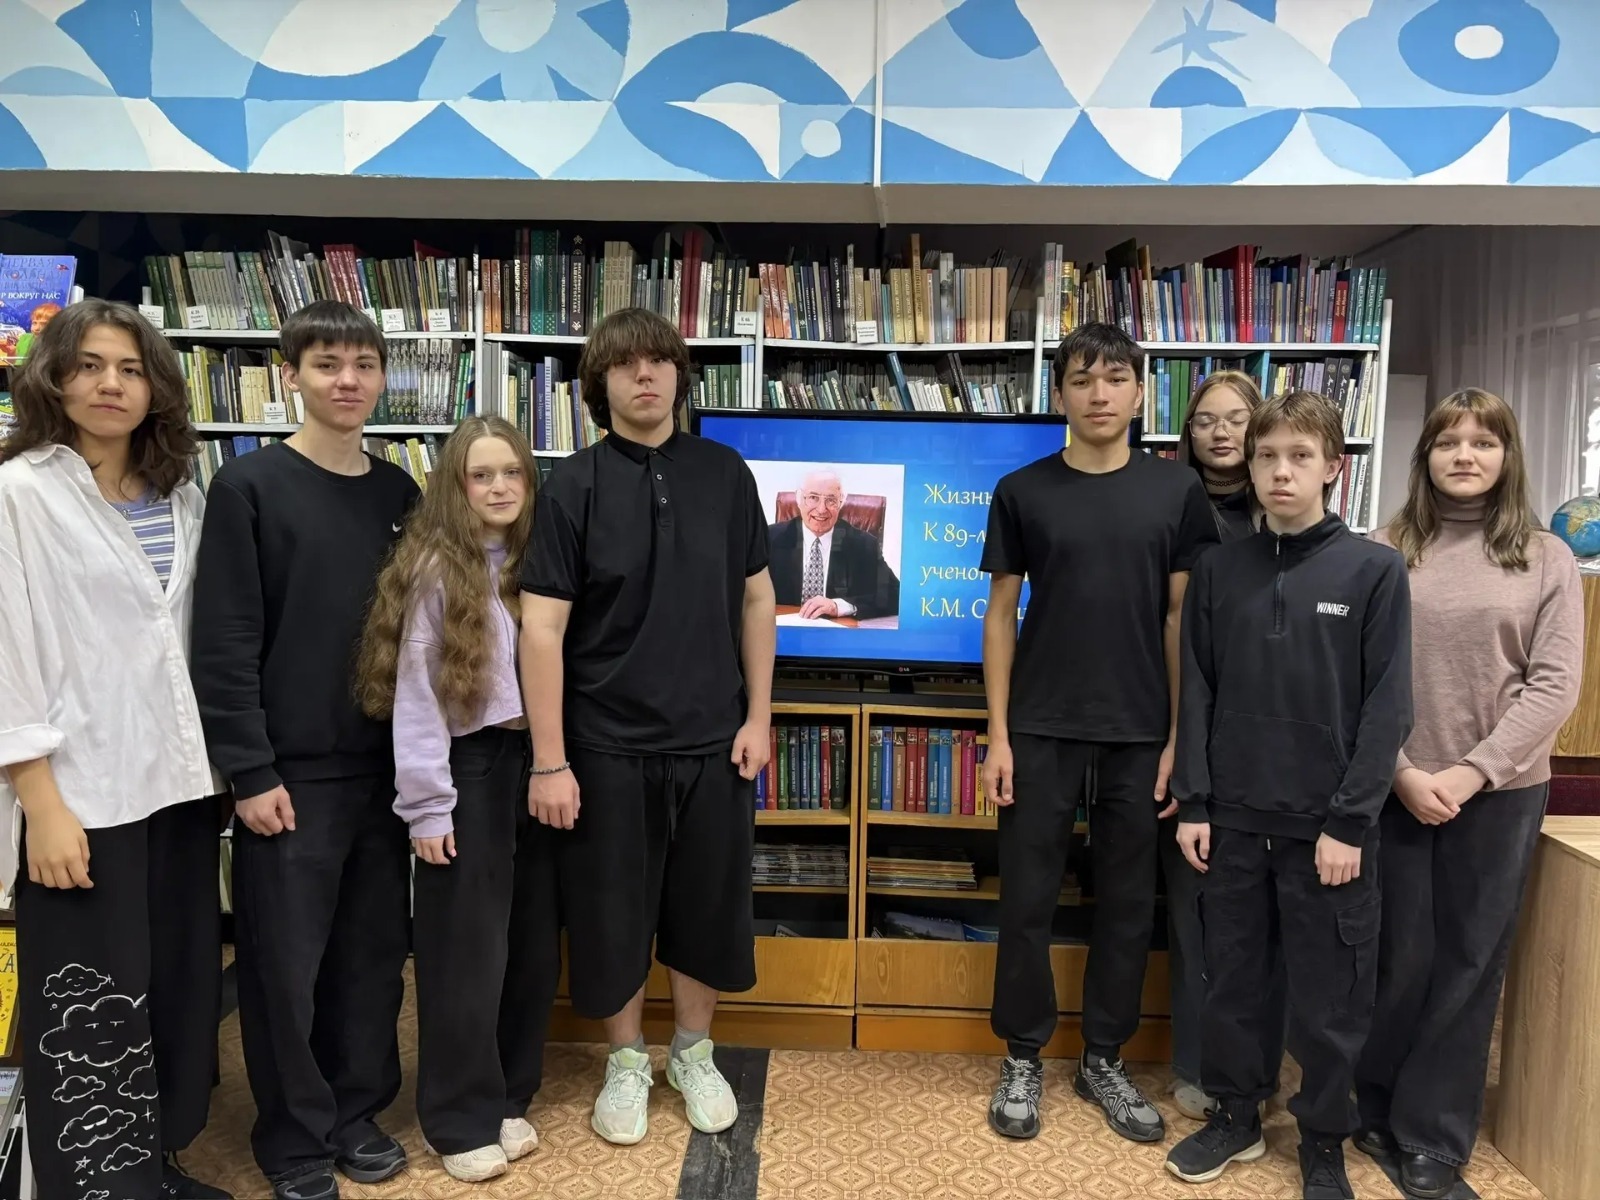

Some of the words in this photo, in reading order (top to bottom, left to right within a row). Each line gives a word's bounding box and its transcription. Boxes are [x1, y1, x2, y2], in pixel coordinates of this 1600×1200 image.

[8, 292, 40, 300] ВОКРУГ
[41, 292, 61, 300] НАС
[923, 522, 938, 542] К
[921, 597, 965, 618] К.М.
[1316, 602, 1350, 616] WINNER
